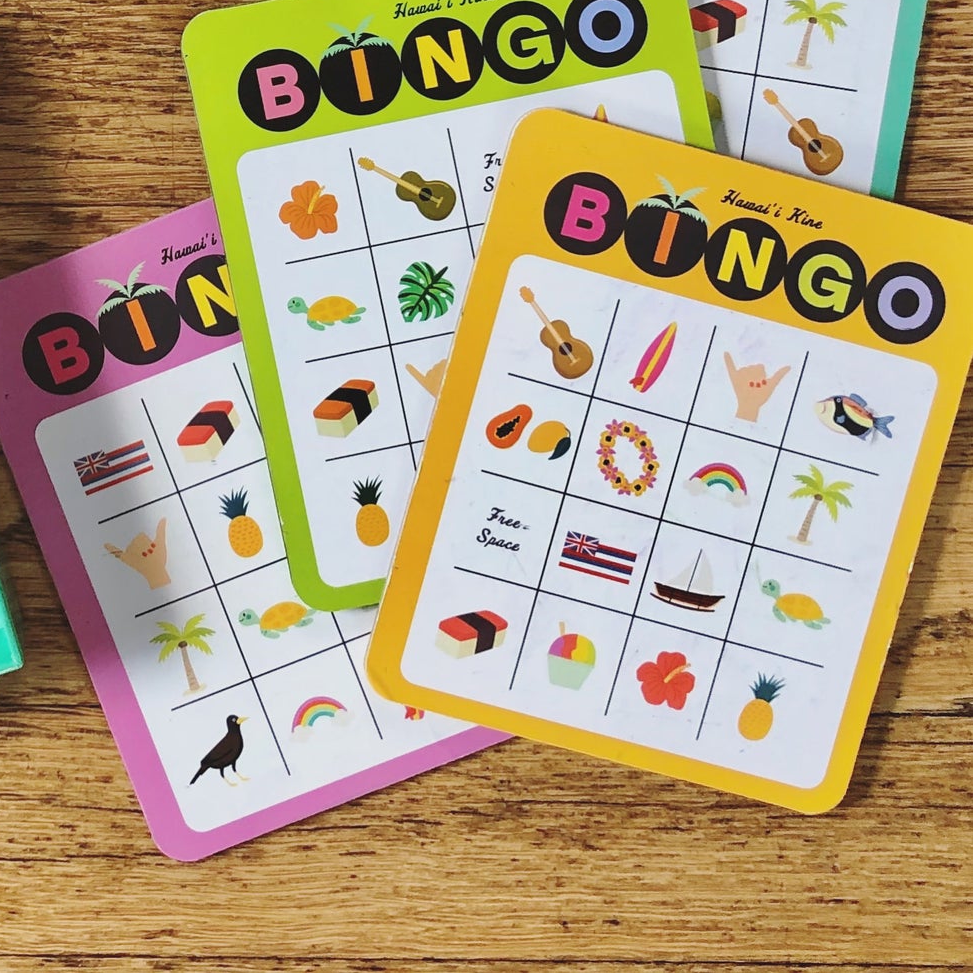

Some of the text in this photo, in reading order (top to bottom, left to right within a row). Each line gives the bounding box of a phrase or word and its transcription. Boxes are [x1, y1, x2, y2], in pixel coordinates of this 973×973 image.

[785, 206, 824, 230] Kine
[559, 183, 934, 331] BINGO
[37, 263, 238, 386] BIN
[486, 506, 521, 529] Free
[475, 527, 521, 552] Space
